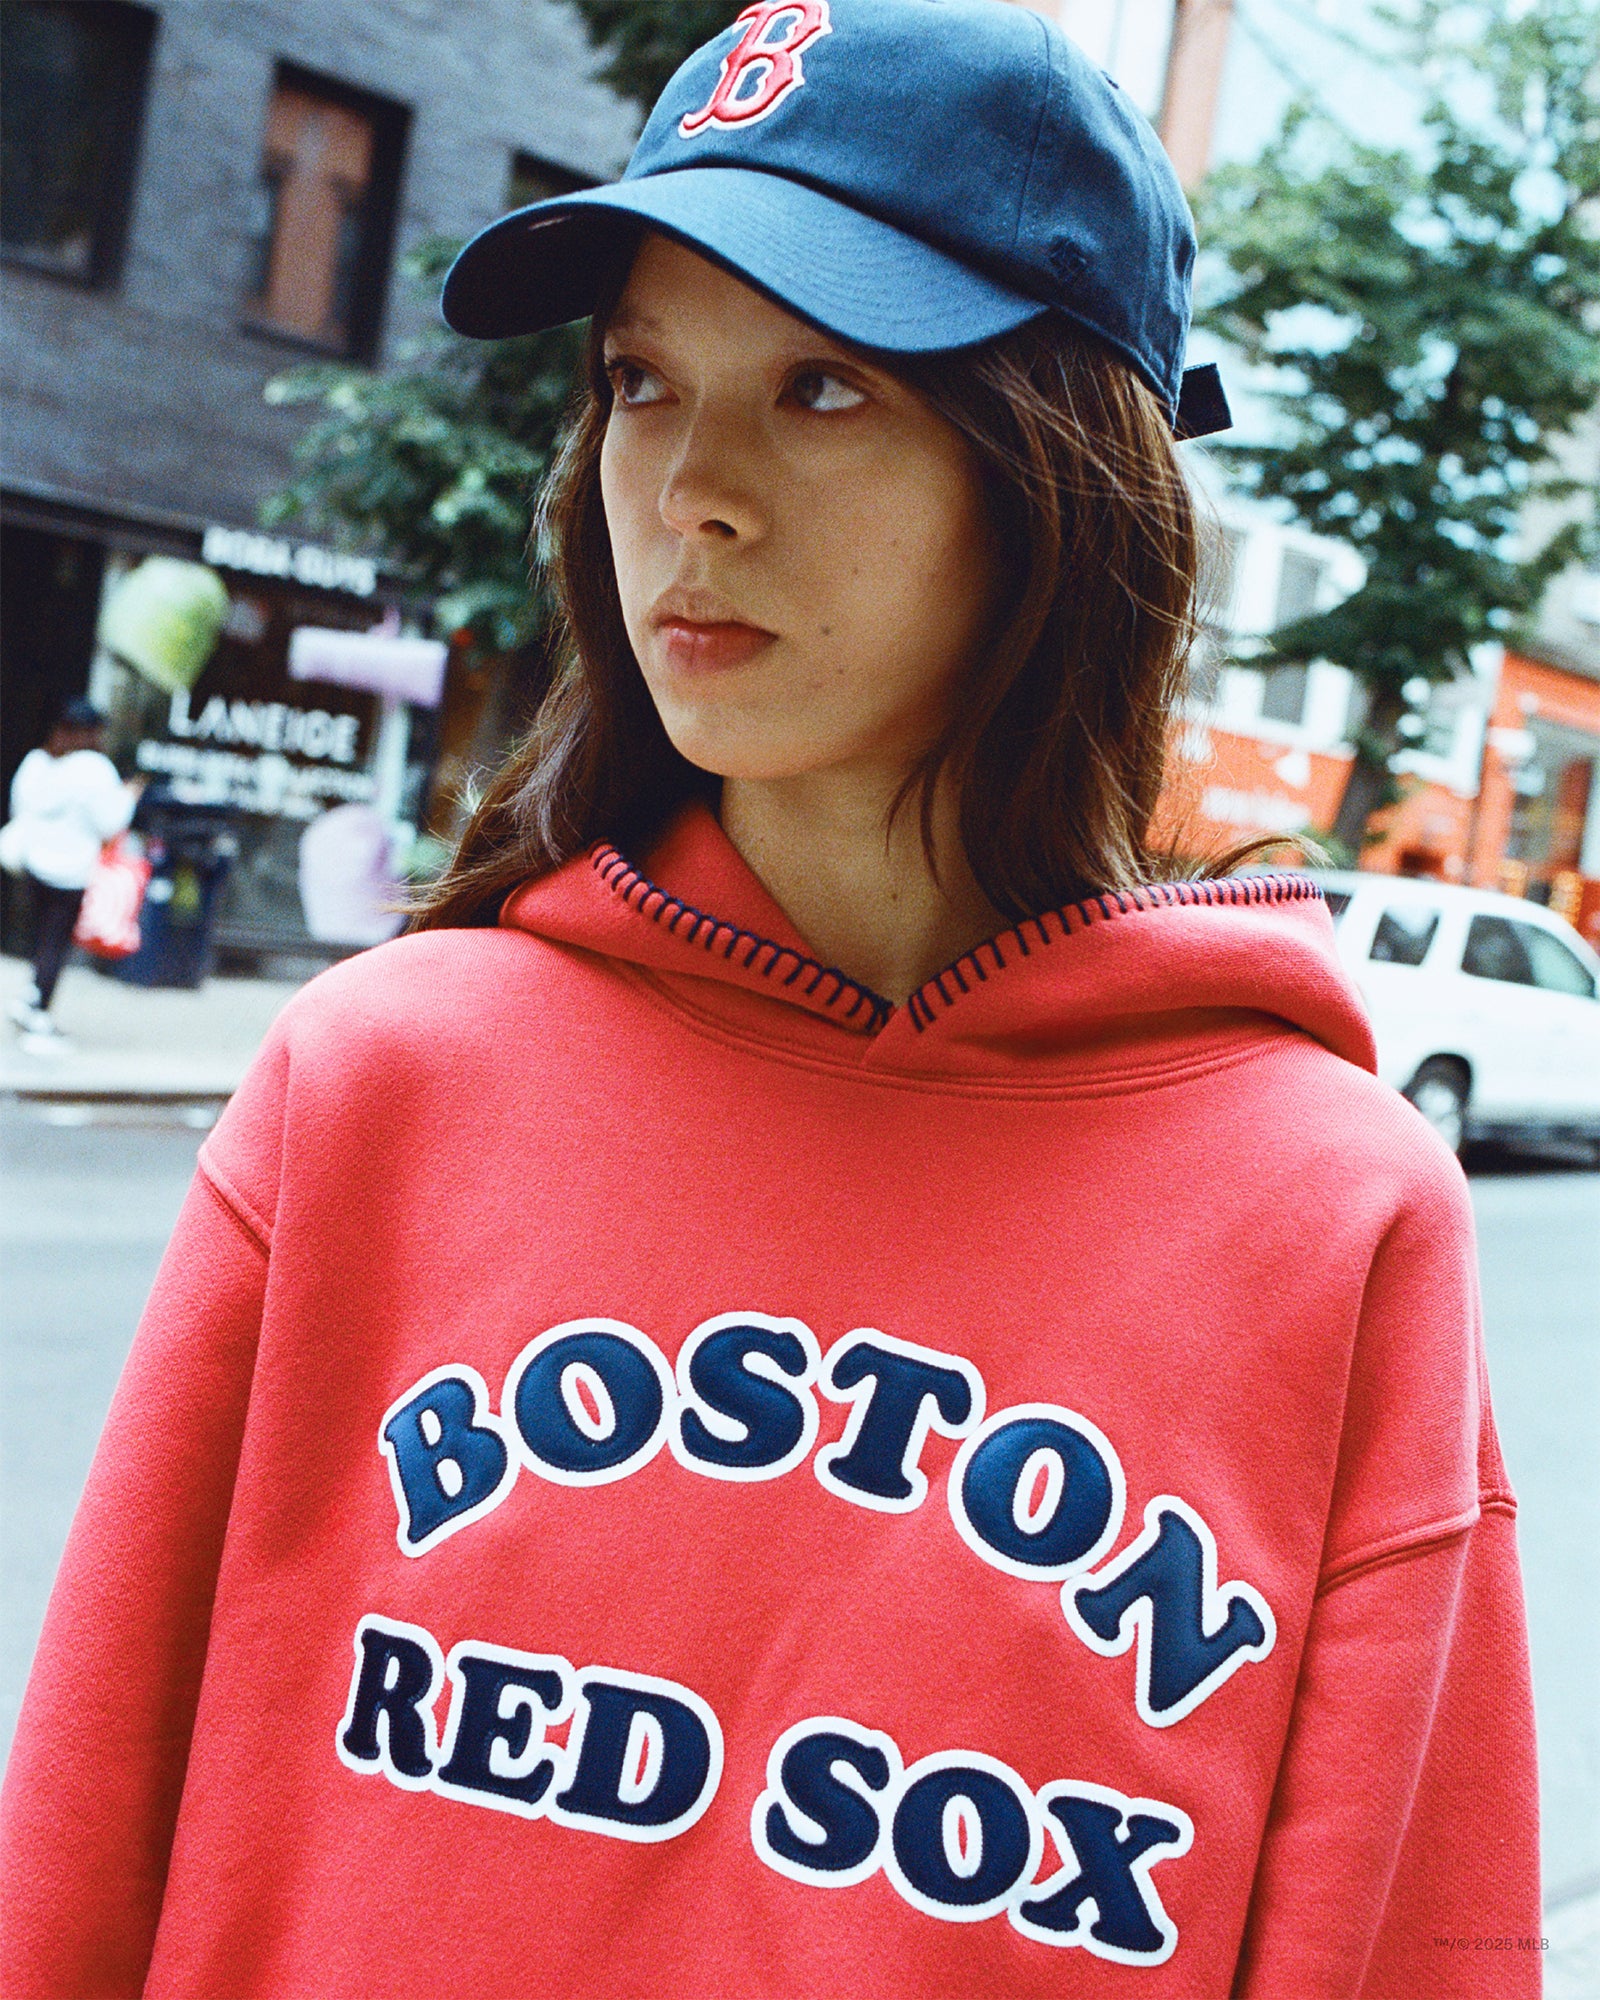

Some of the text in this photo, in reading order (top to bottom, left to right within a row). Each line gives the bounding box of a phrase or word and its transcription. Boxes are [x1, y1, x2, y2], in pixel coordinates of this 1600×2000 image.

[678, 0, 832, 138] B
[378, 1311, 1276, 1727] BOSTON
[335, 1613, 1194, 1967] RED SOX
